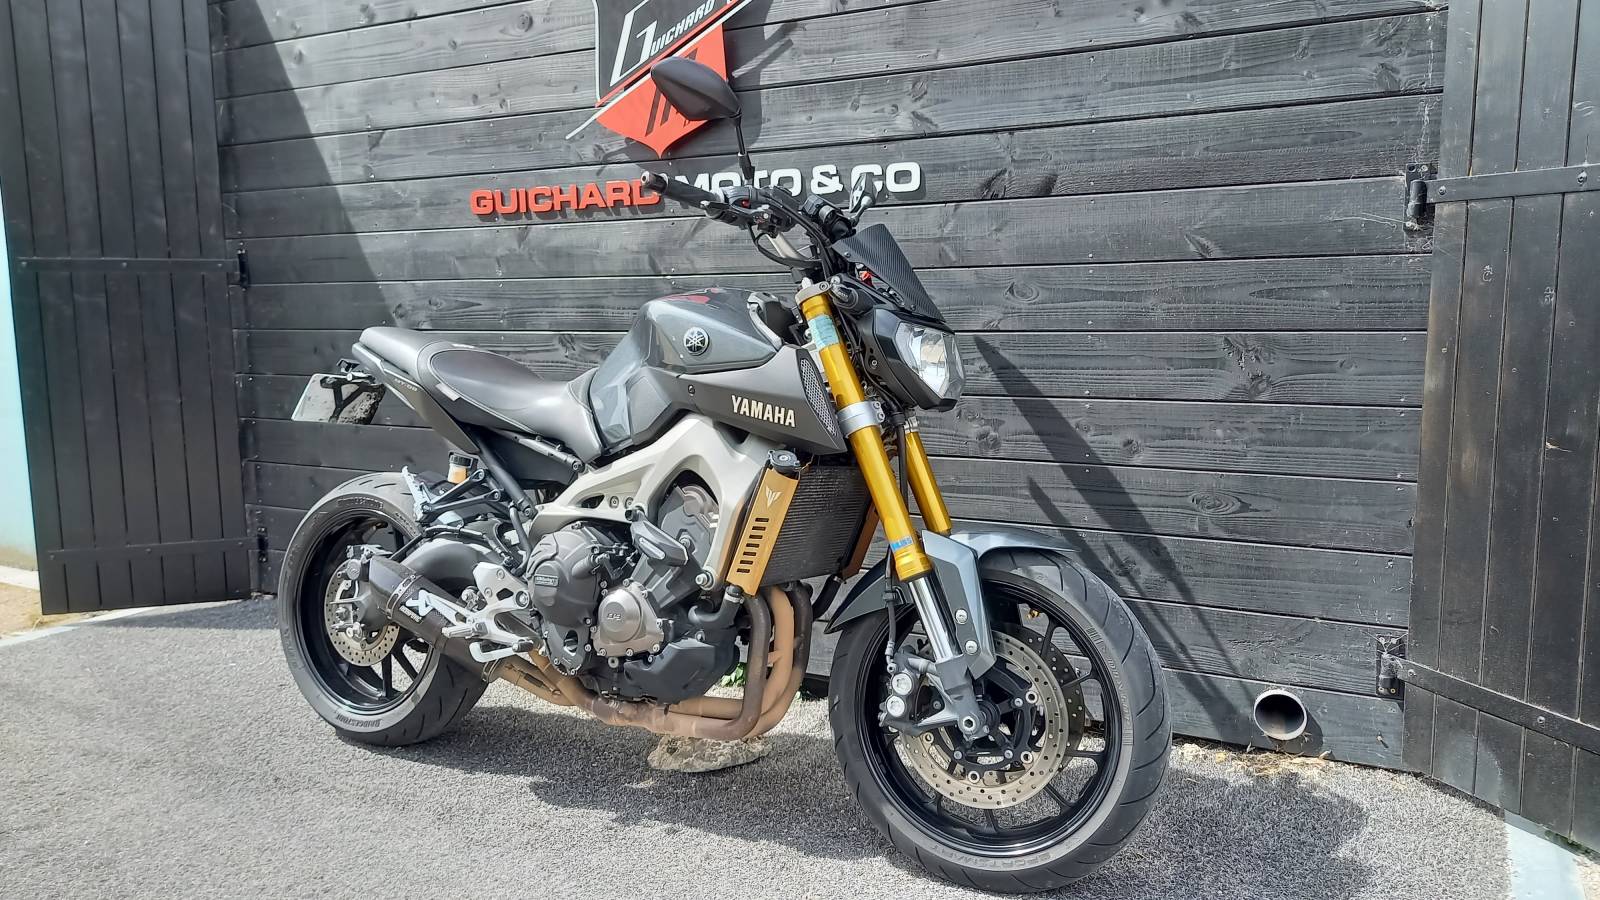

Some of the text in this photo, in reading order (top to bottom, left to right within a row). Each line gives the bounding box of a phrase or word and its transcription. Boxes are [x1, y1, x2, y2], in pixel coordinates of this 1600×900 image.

[470, 178, 660, 215] GUICHARD
[811, 165, 843, 194] &
[851, 162, 920, 195] CO
[731, 395, 796, 428] YAMAHA
